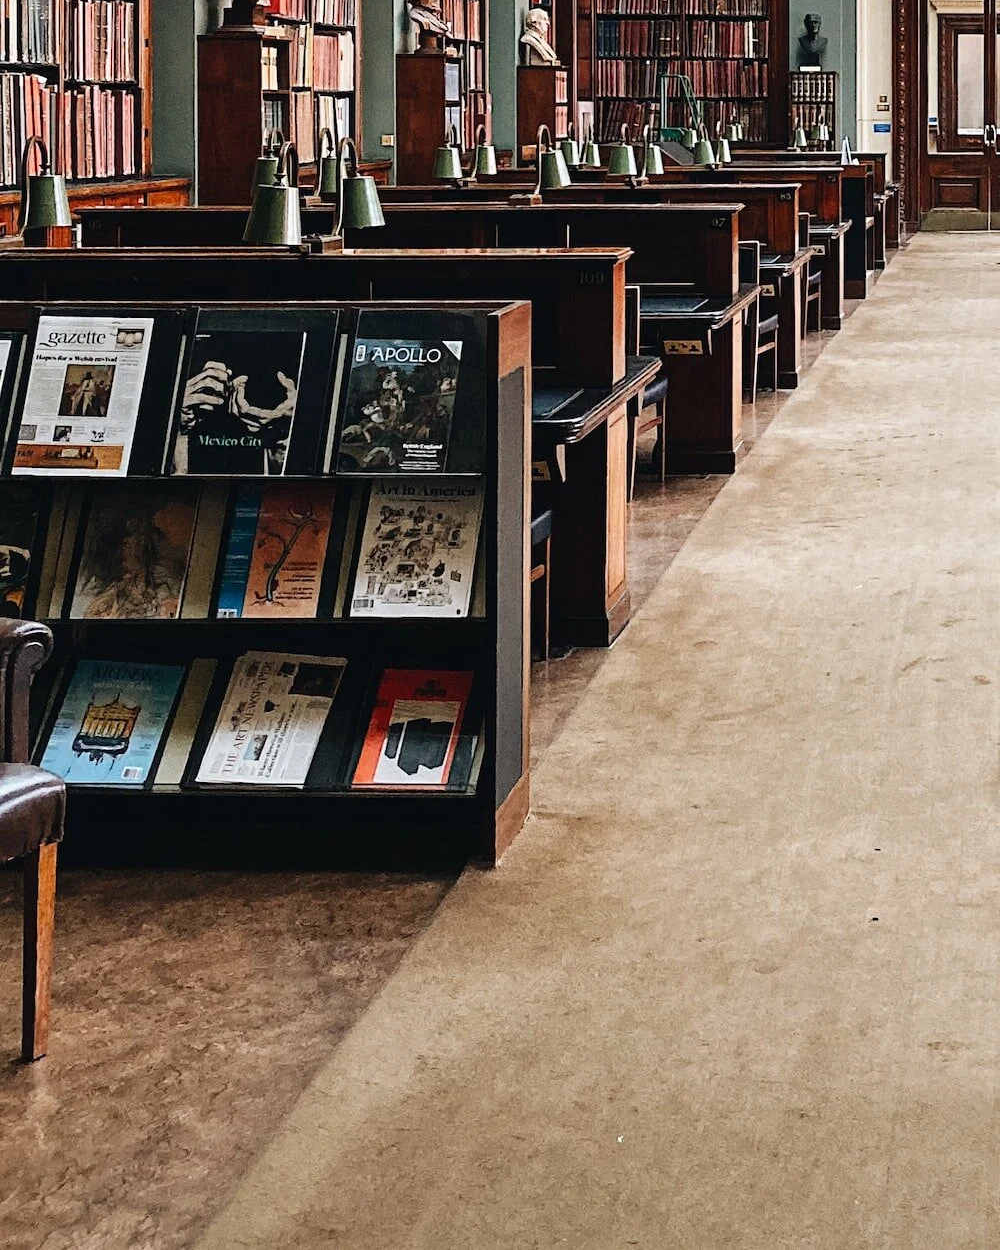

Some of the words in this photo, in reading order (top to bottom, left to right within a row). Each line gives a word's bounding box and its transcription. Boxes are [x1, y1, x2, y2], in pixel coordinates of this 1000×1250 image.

[711, 217, 726, 227] 97
[580, 271, 605, 284] 109
[39, 330, 106, 347] gazette
[371, 347, 442, 362] APOLLO
[199, 435, 238, 447] Mexico
[240, 435, 262, 449] City
[221, 751, 238, 774] THE
[231, 728, 248, 749] ART
